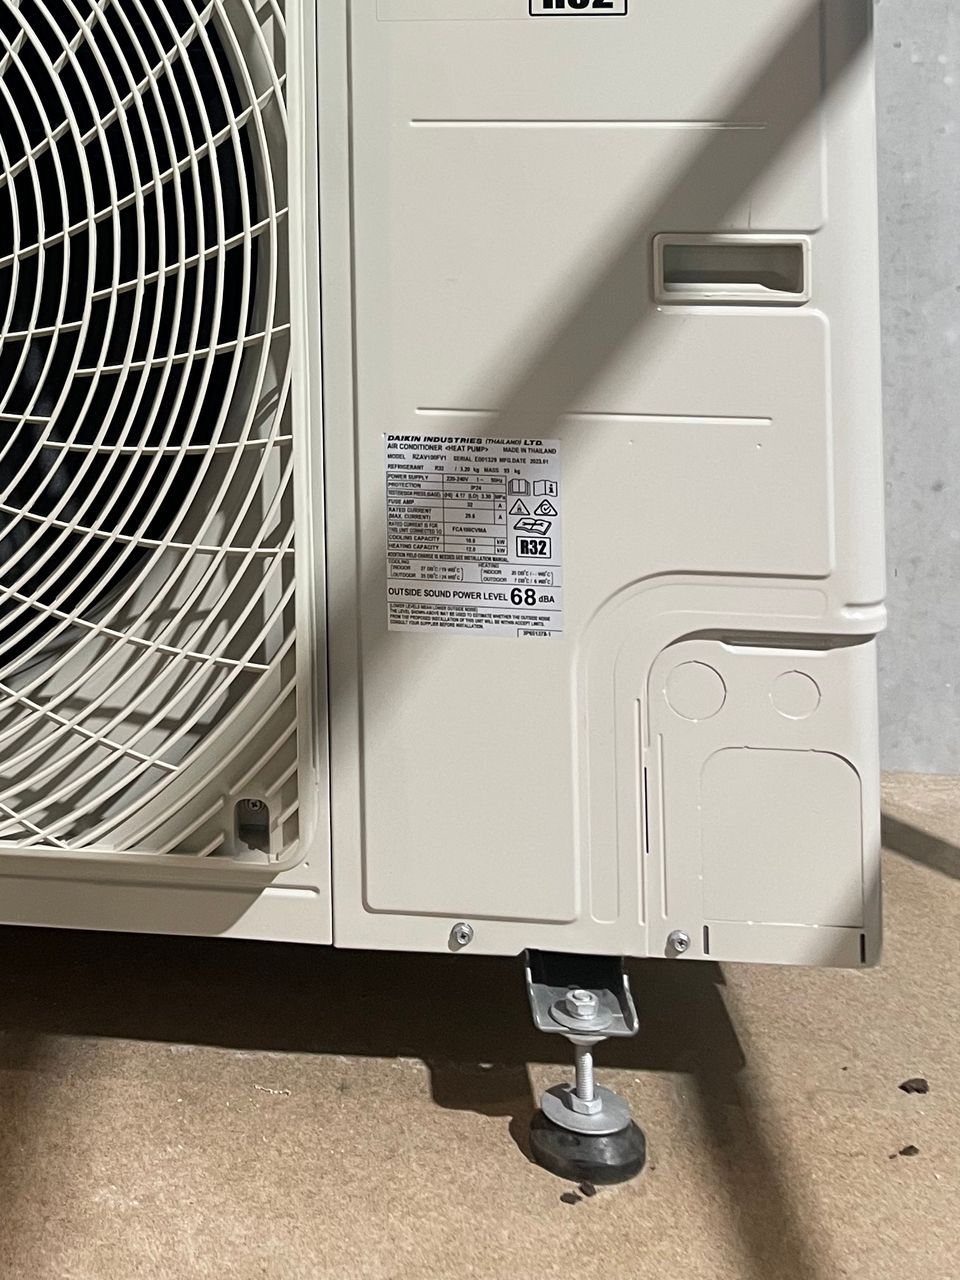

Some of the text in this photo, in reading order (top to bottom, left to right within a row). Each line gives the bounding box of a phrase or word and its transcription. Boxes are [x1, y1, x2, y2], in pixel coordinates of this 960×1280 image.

[423, 436, 482, 445] INDUSTRIES
[520, 539, 547, 556] R32
[388, 587, 555, 606] OUTSIDE SOUND POWER LEVEL 68 dBA
